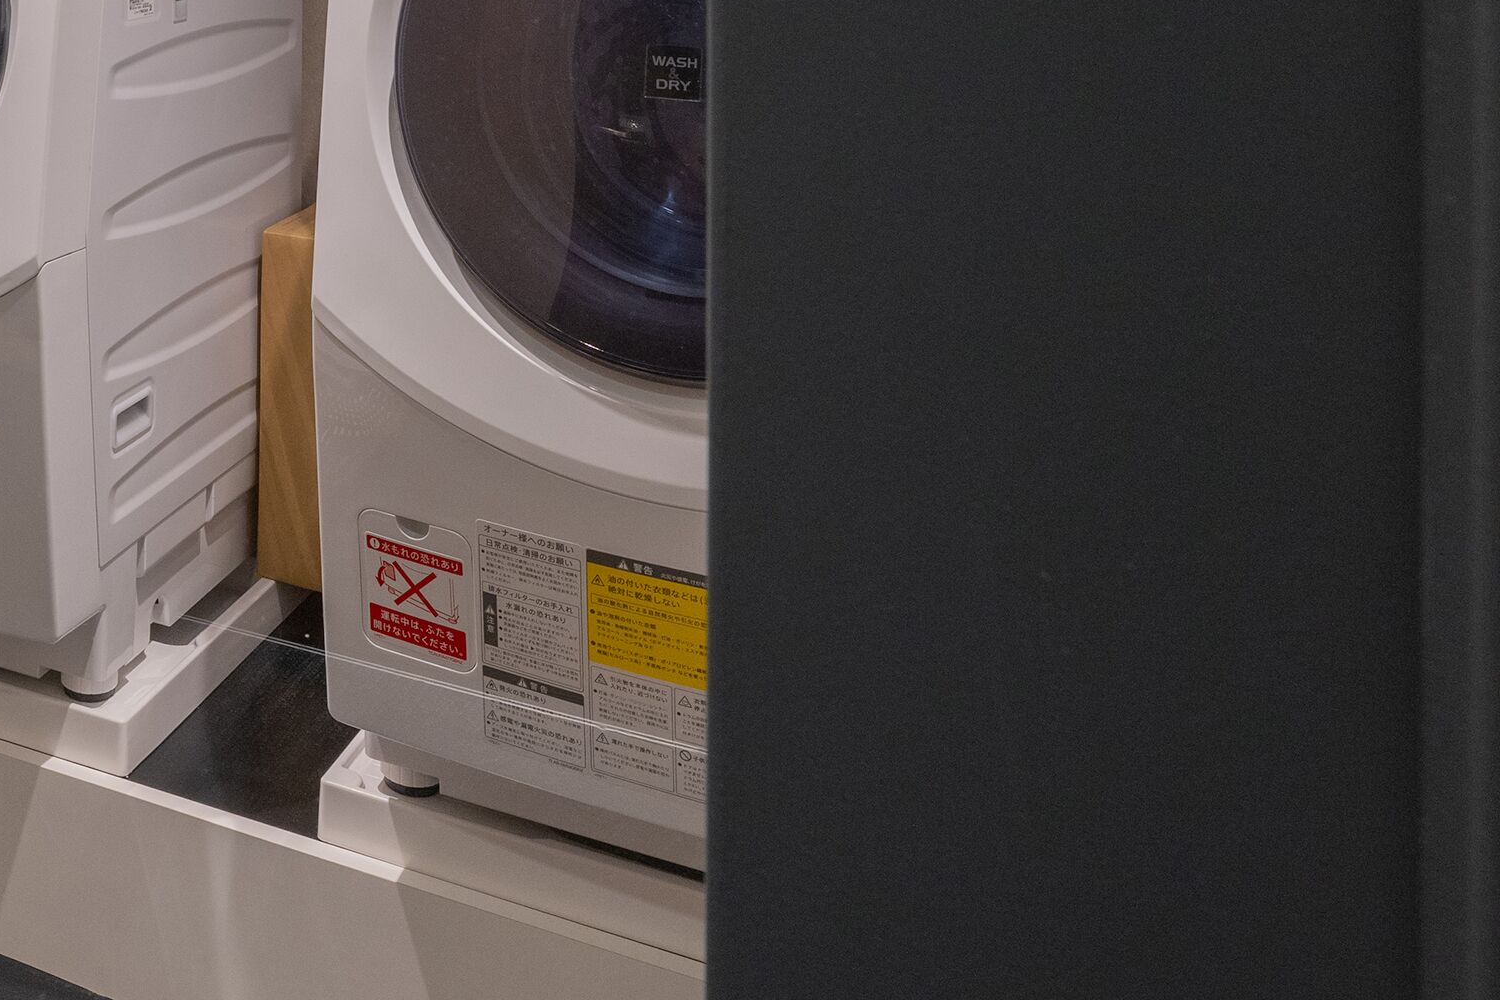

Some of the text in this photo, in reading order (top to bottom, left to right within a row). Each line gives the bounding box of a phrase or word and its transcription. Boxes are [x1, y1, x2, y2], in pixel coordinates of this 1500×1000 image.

[652, 55, 698, 69] WASH
[668, 67, 680, 79] &
[656, 78, 692, 91] DRY
[483, 524, 574, 554] オーナー様へのお願い
[380, 541, 459, 572] 水もれの恐れあり
[485, 538, 573, 567] 日常点検・清掃のお願い
[633, 563, 654, 576] 警告
[488, 584, 573, 614] 排水フィルターのお手入れ
[608, 585, 680, 608] 絶対に乾燥しない
[485, 614, 495, 633] 注意
[505, 602, 566, 624] 水漏れの恐れあり
[380, 608, 455, 641] 運転中は、ふたを
[373, 619, 464, 657] 開けないでください。
[500, 684, 546, 704] 発火の恐れあり
[529, 681, 549, 695] 警告
[610, 683, 668, 703] 入れたり、近づけない
[500, 715, 581, 745] 感電や漏電火災の恐れあり
[611, 739, 669, 759] 濡れた手で操作しない
